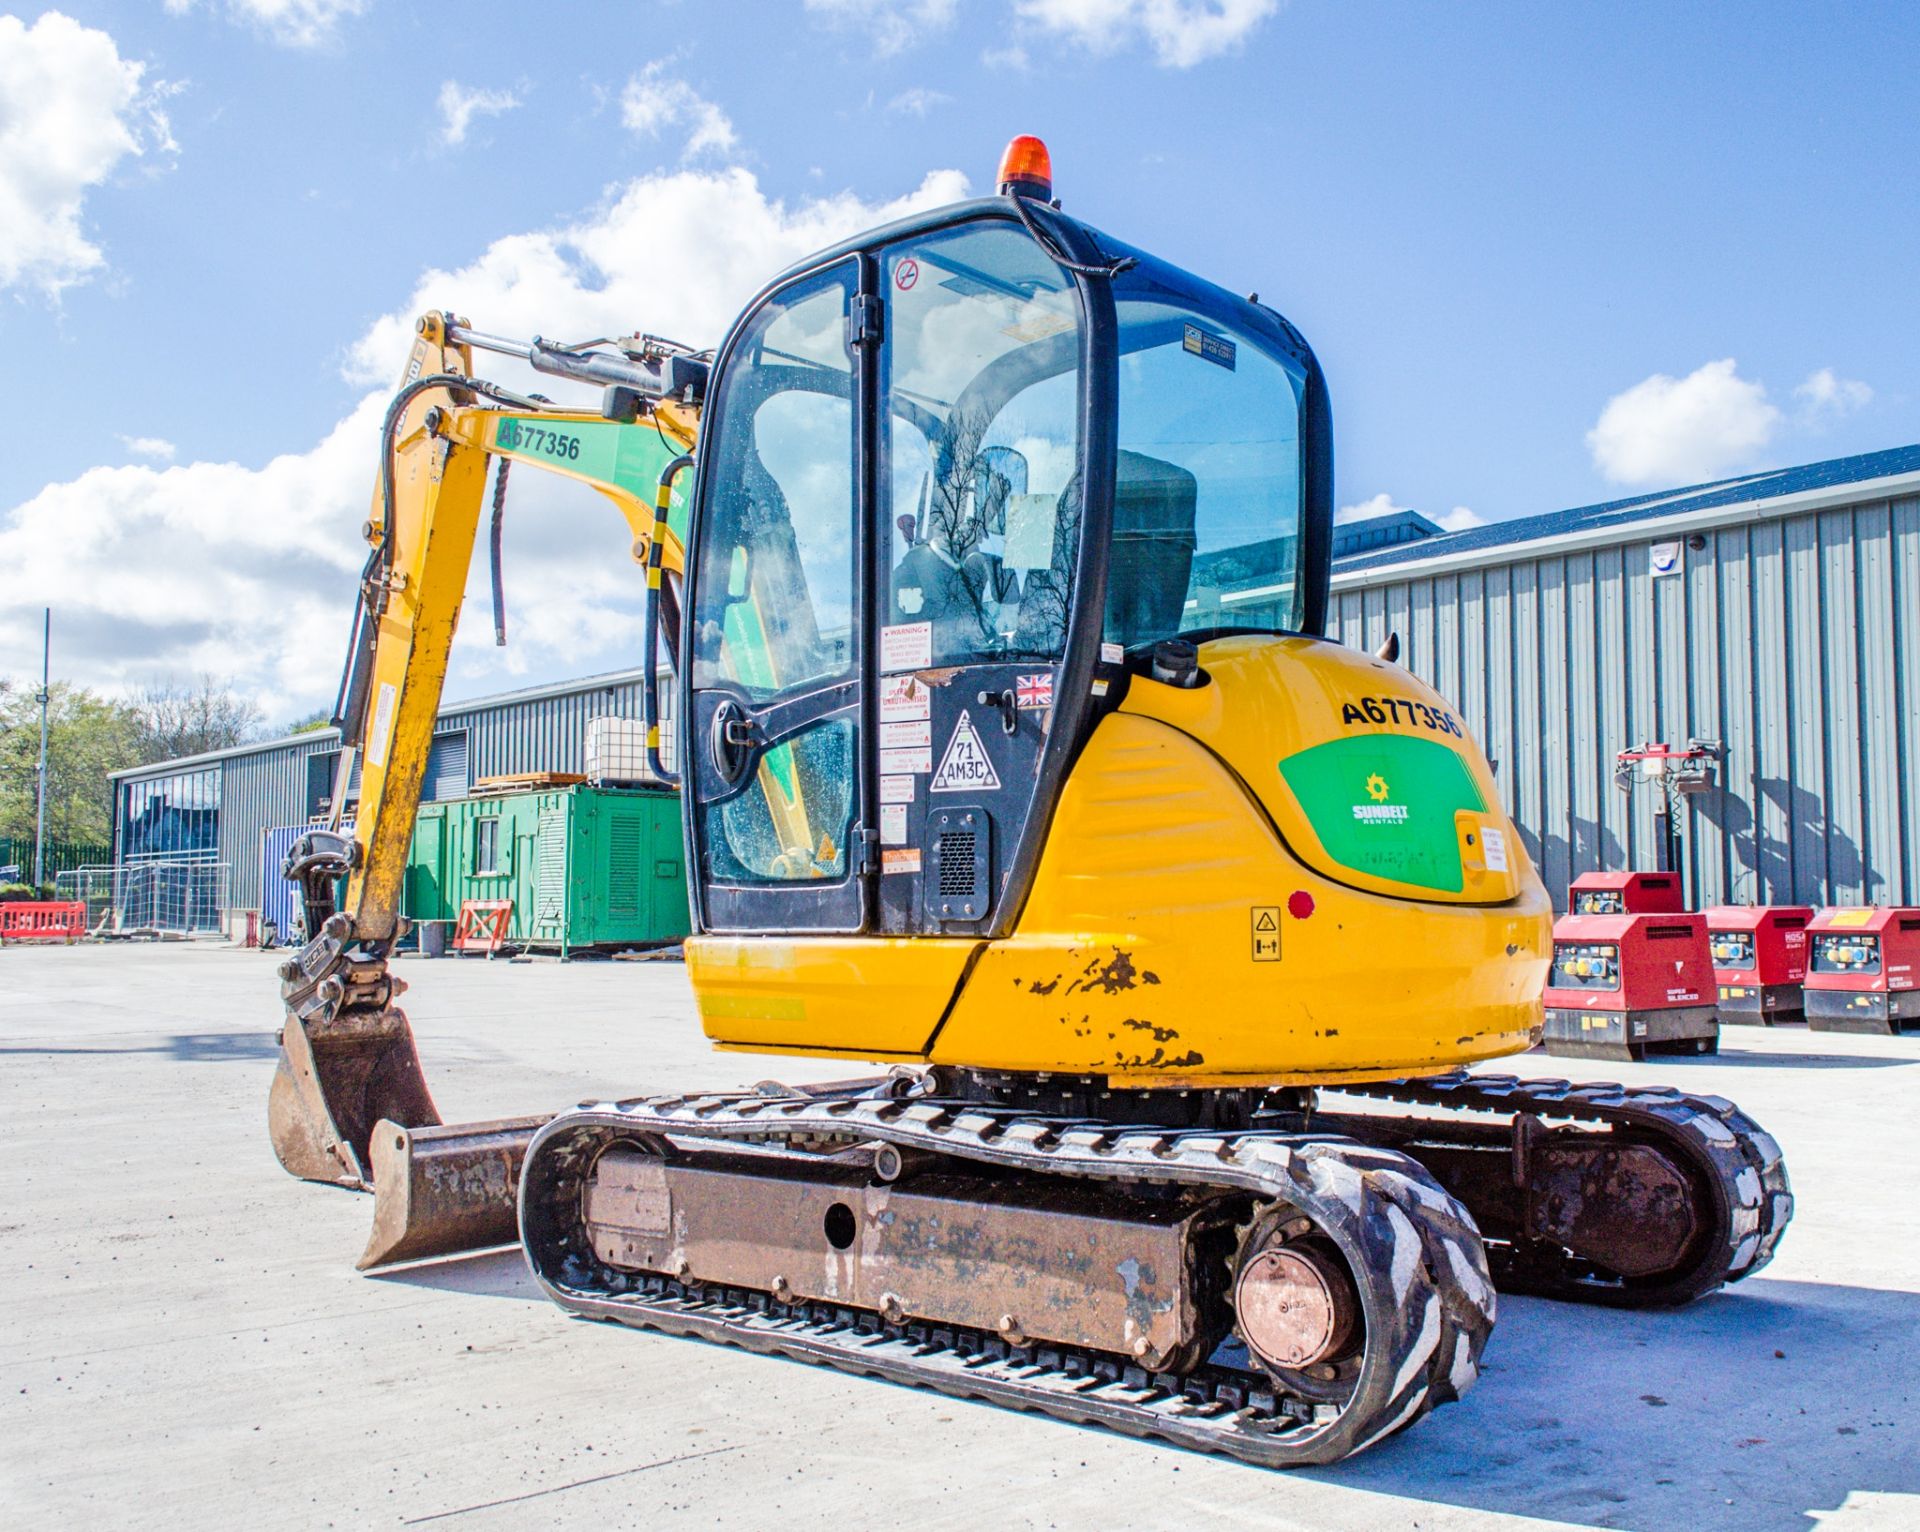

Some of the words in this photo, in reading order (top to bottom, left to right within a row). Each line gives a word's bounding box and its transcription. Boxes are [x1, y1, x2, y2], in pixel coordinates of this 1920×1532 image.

[498, 421, 580, 460] A677356
[890, 626, 922, 636] WARNING
[1342, 697, 1463, 738] A677356
[957, 742, 973, 760] 71
[947, 761, 984, 780] AM3C
[1352, 805, 1408, 819] SUNBELT
[305, 942, 325, 968] JCB
